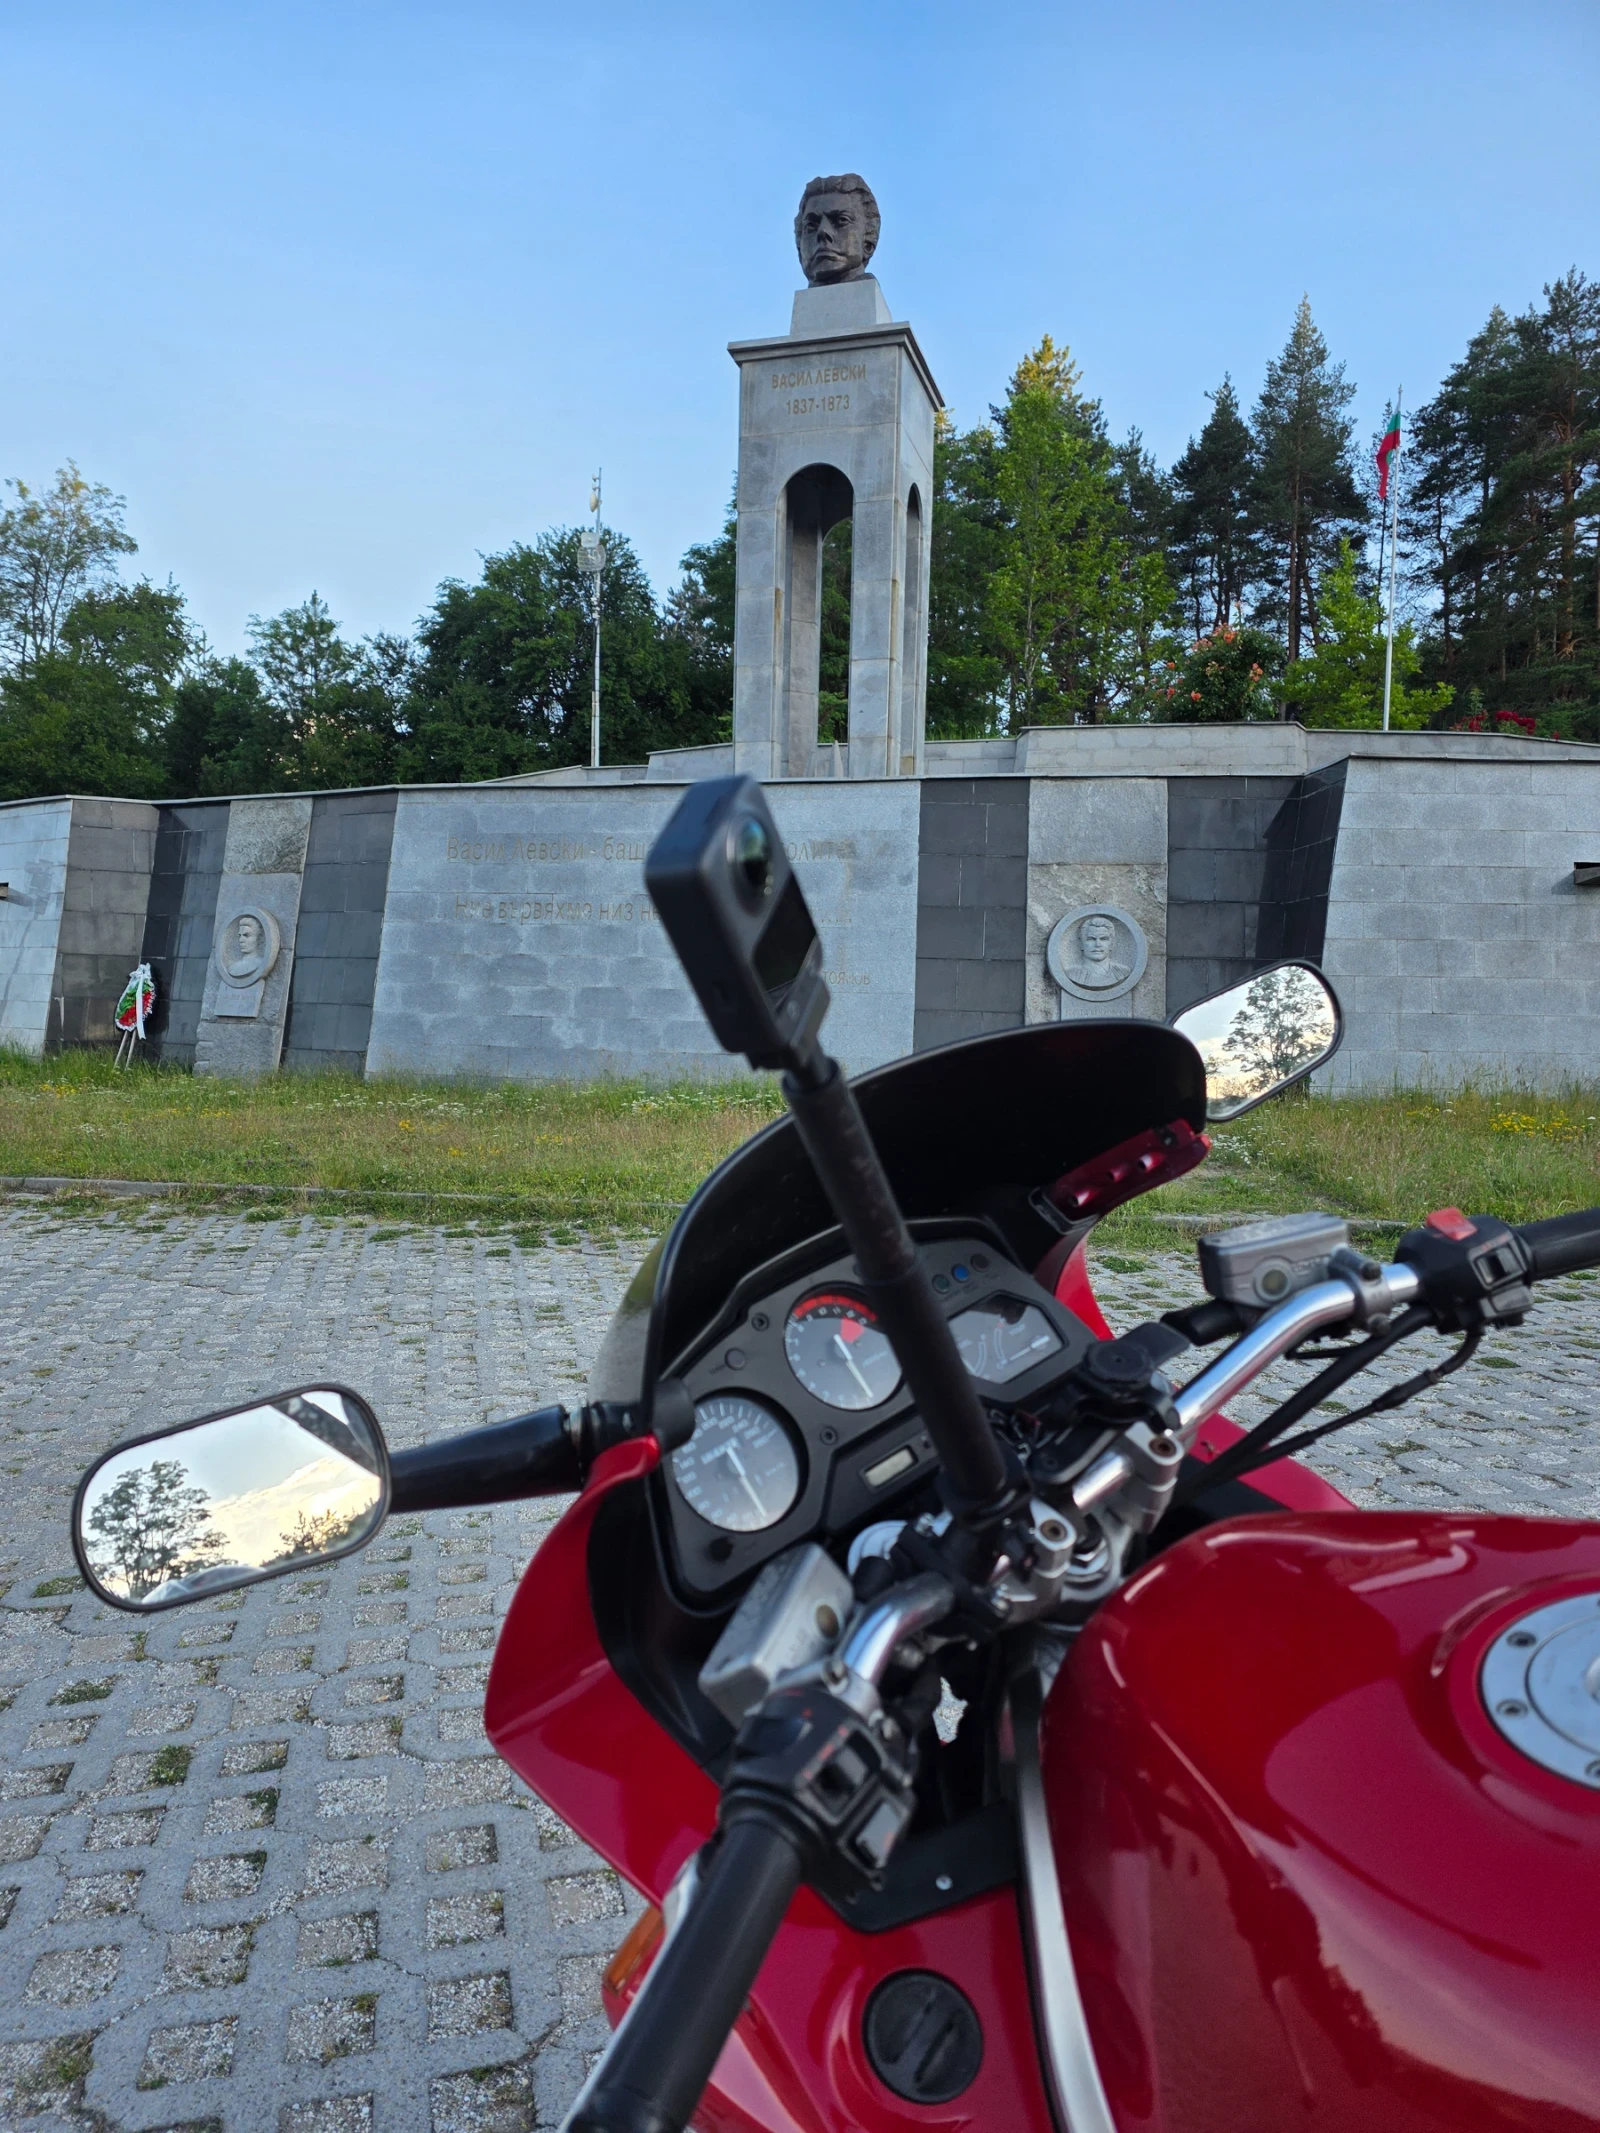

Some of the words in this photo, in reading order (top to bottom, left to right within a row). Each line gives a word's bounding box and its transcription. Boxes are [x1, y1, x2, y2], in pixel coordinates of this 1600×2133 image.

[771, 372, 813, 389] ВАСИЛ
[815, 364, 866, 385] ЛЕВСКИ
[786, 394, 850, 416] 1837-1873
[447, 837, 505, 860] Васил
[511, 836, 584, 861] Левски
[600, 903, 633, 921] низ
